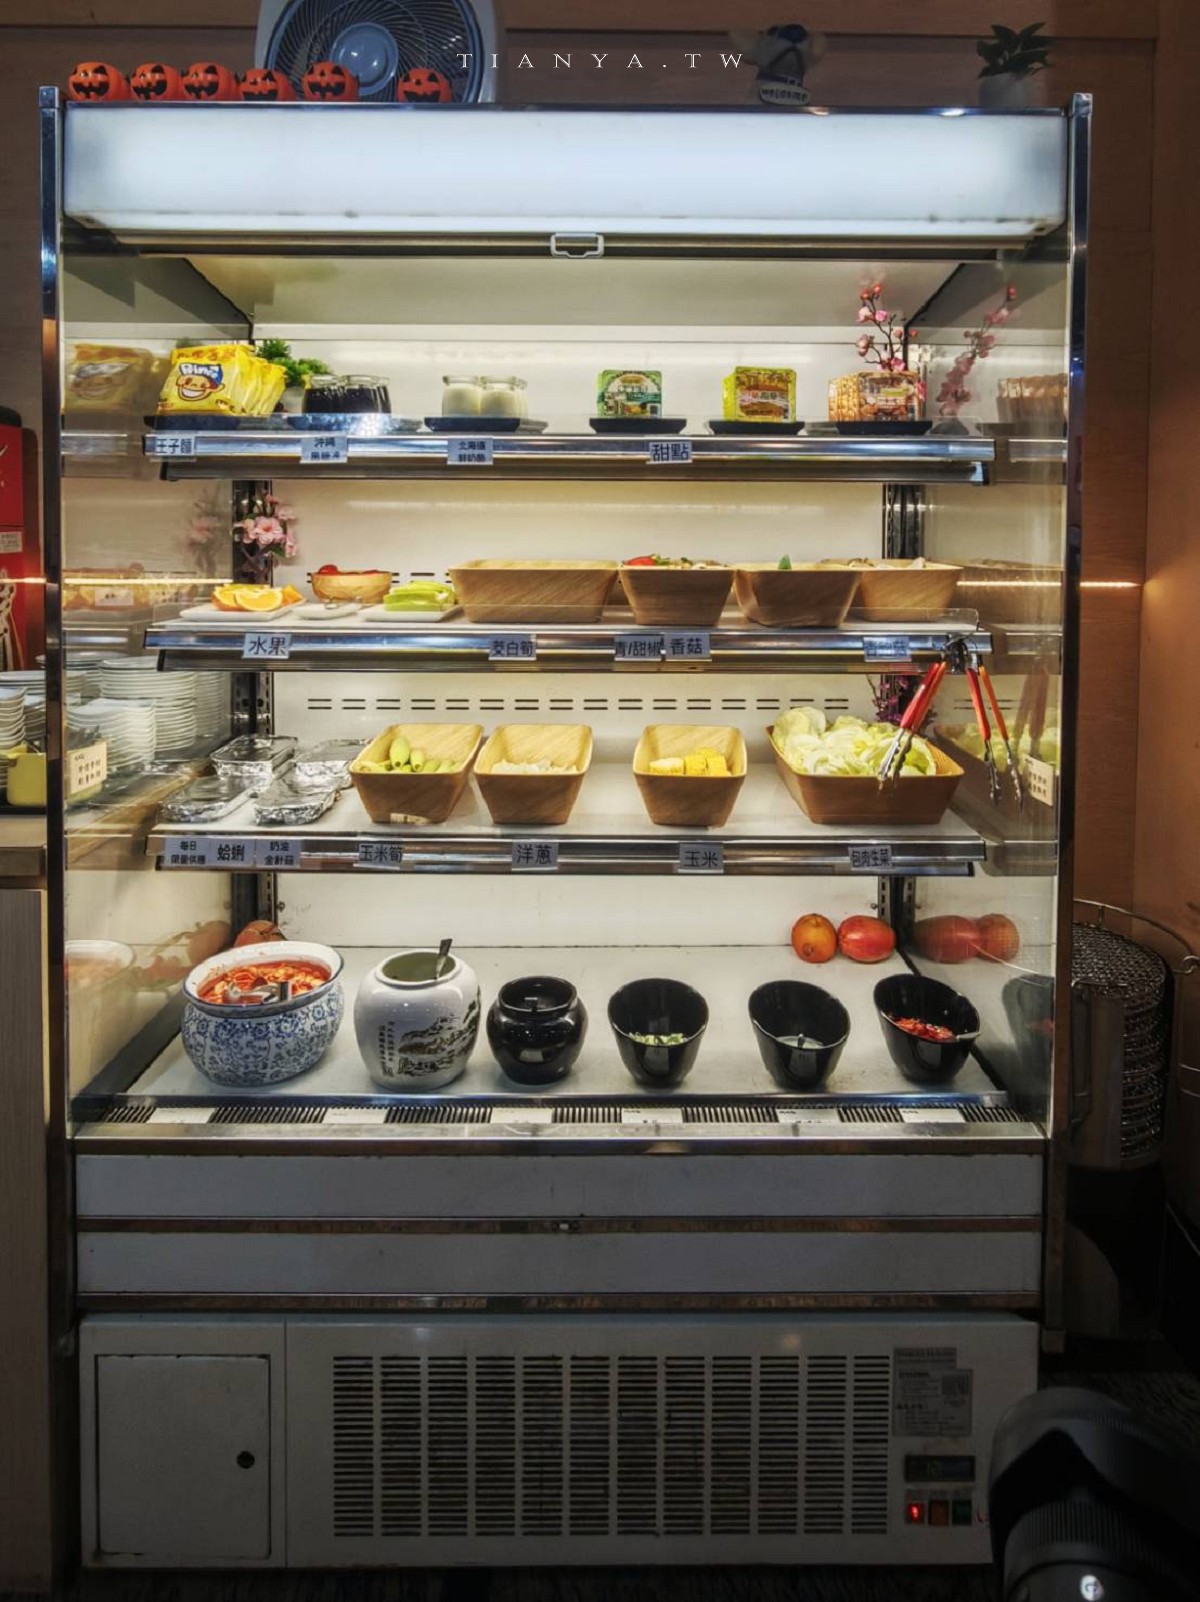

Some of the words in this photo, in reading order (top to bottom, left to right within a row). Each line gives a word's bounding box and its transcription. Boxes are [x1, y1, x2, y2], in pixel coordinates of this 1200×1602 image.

[651, 443, 690, 462] 甜點
[248, 636, 287, 656] 水果
[492, 640, 534, 657] 茭白筍
[670, 637, 703, 655] 香菇
[269, 841, 290, 852] 奶油
[360, 844, 403, 863] 玉米筍
[684, 849, 720, 868] 玉米
